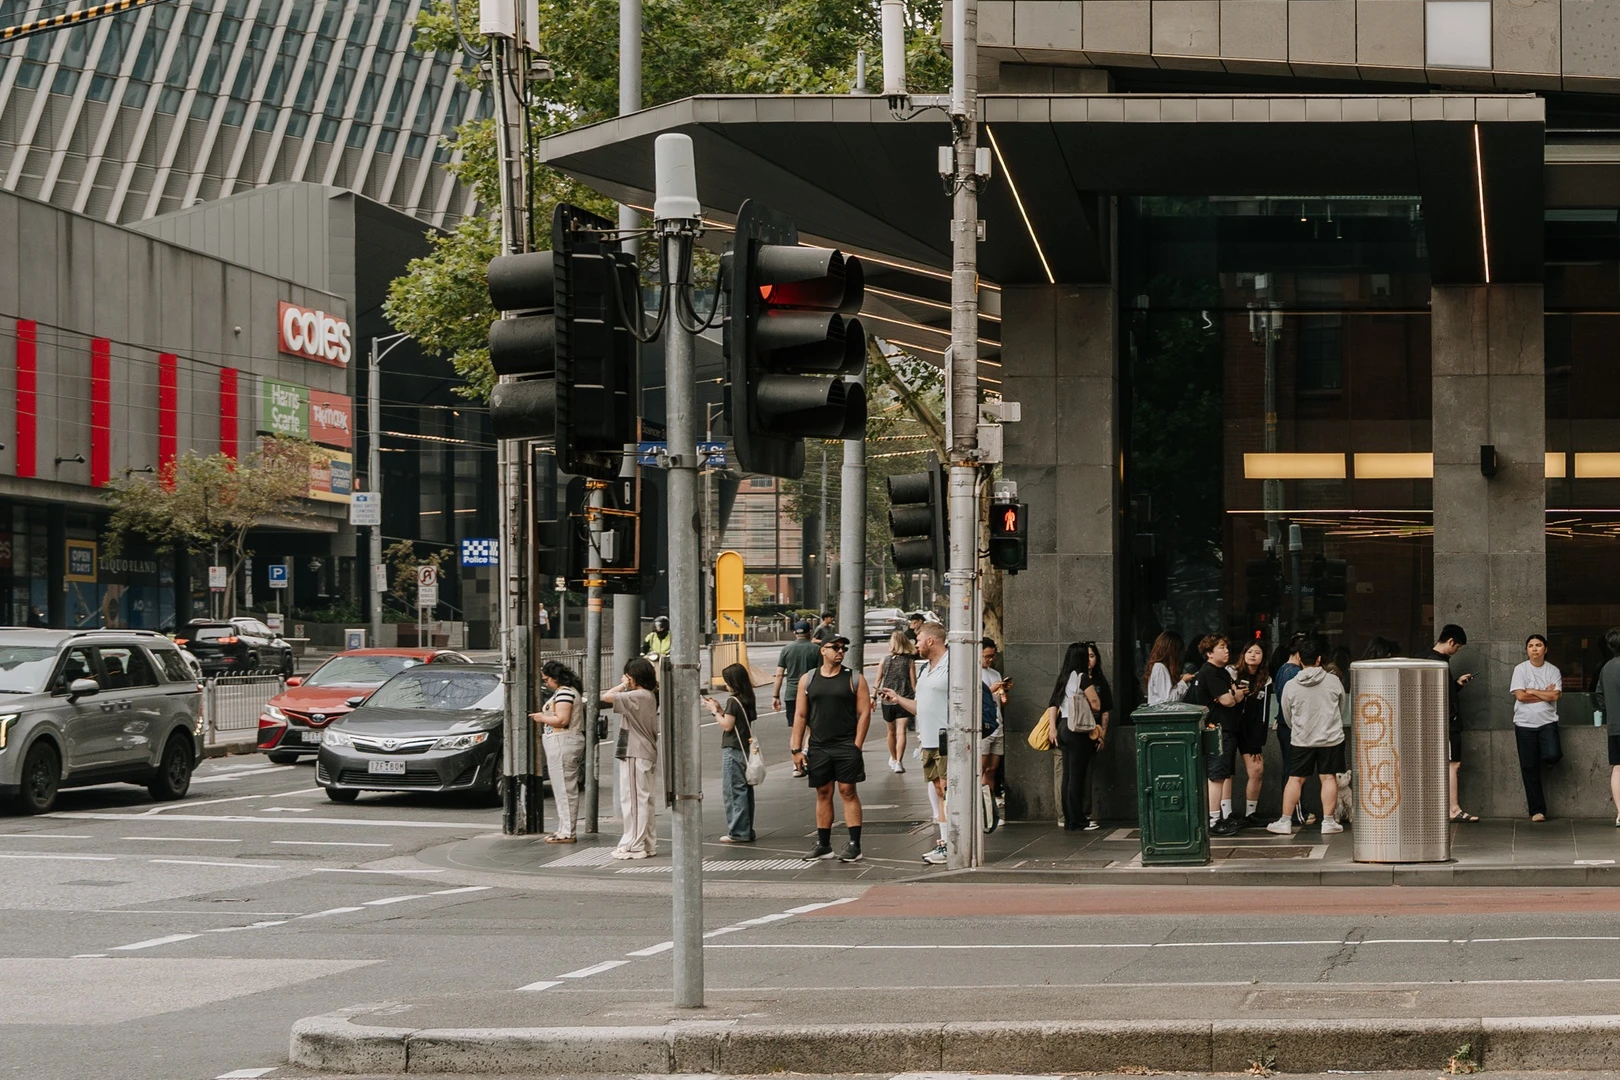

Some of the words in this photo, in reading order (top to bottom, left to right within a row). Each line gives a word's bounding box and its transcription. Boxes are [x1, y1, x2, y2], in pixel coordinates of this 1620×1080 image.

[283, 308, 351, 363] coles
[271, 383, 300, 410] Harris
[271, 406, 300, 433] Scarfe
[72, 550, 91, 562] OPEN
[463, 556, 488, 564] Police
[99, 558, 157, 574] LIQUORLAND
[273, 568, 283, 579] P
